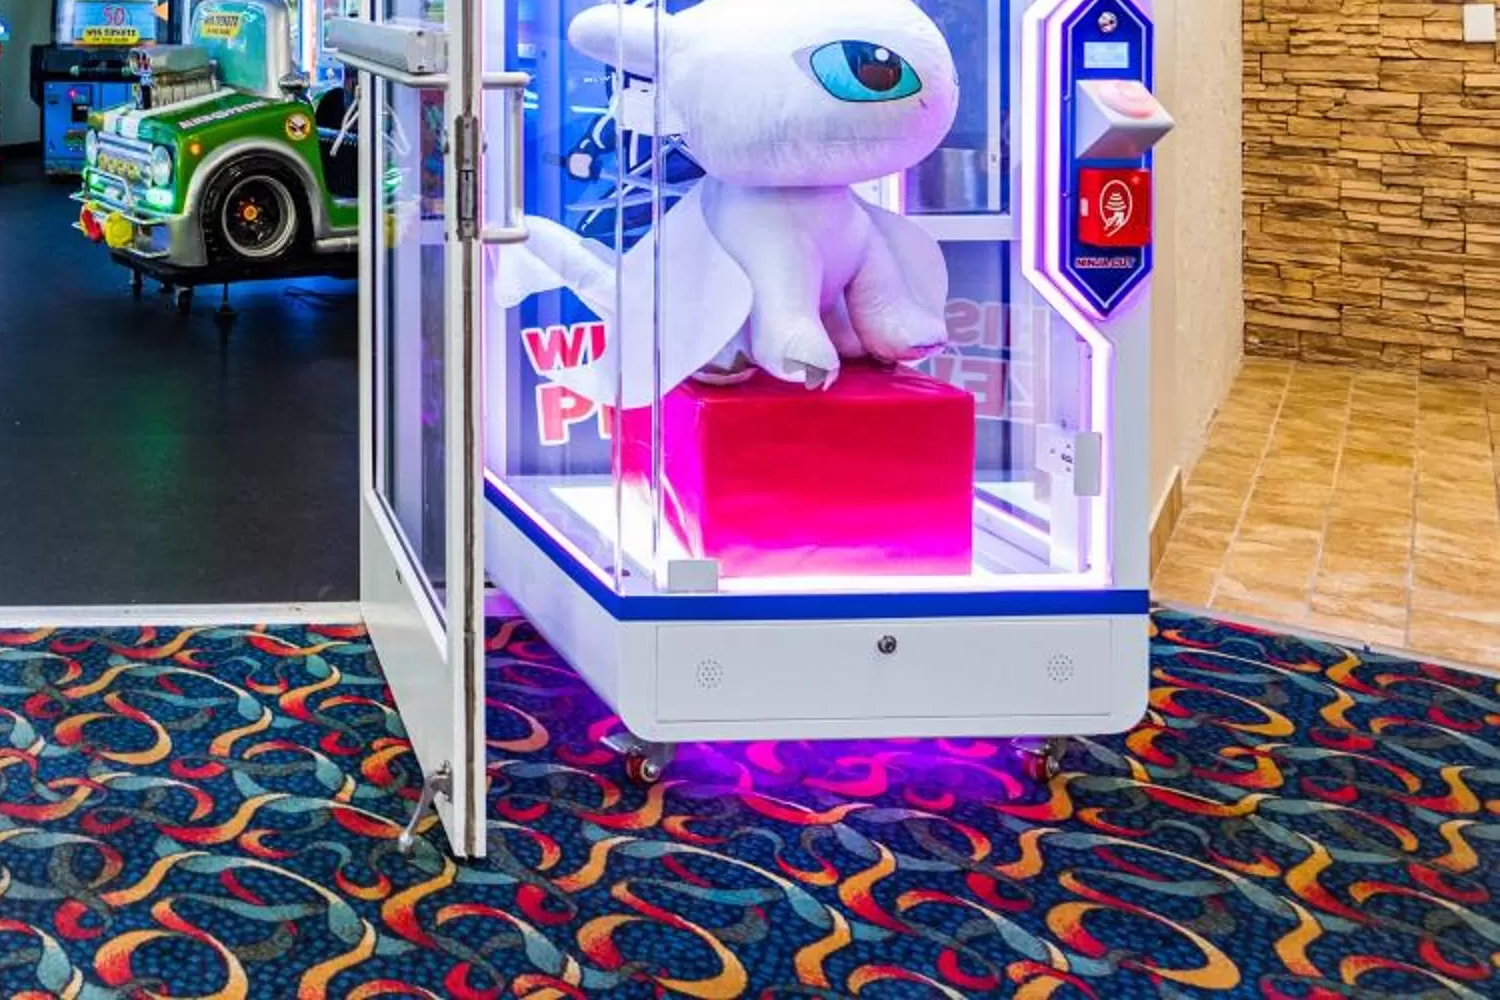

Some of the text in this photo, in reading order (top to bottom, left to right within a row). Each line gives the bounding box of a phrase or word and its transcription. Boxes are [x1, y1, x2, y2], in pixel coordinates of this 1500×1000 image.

[103, 6, 125, 26] 50
[1076, 256, 1109, 268] NINJA
[522, 322, 608, 376] WI
